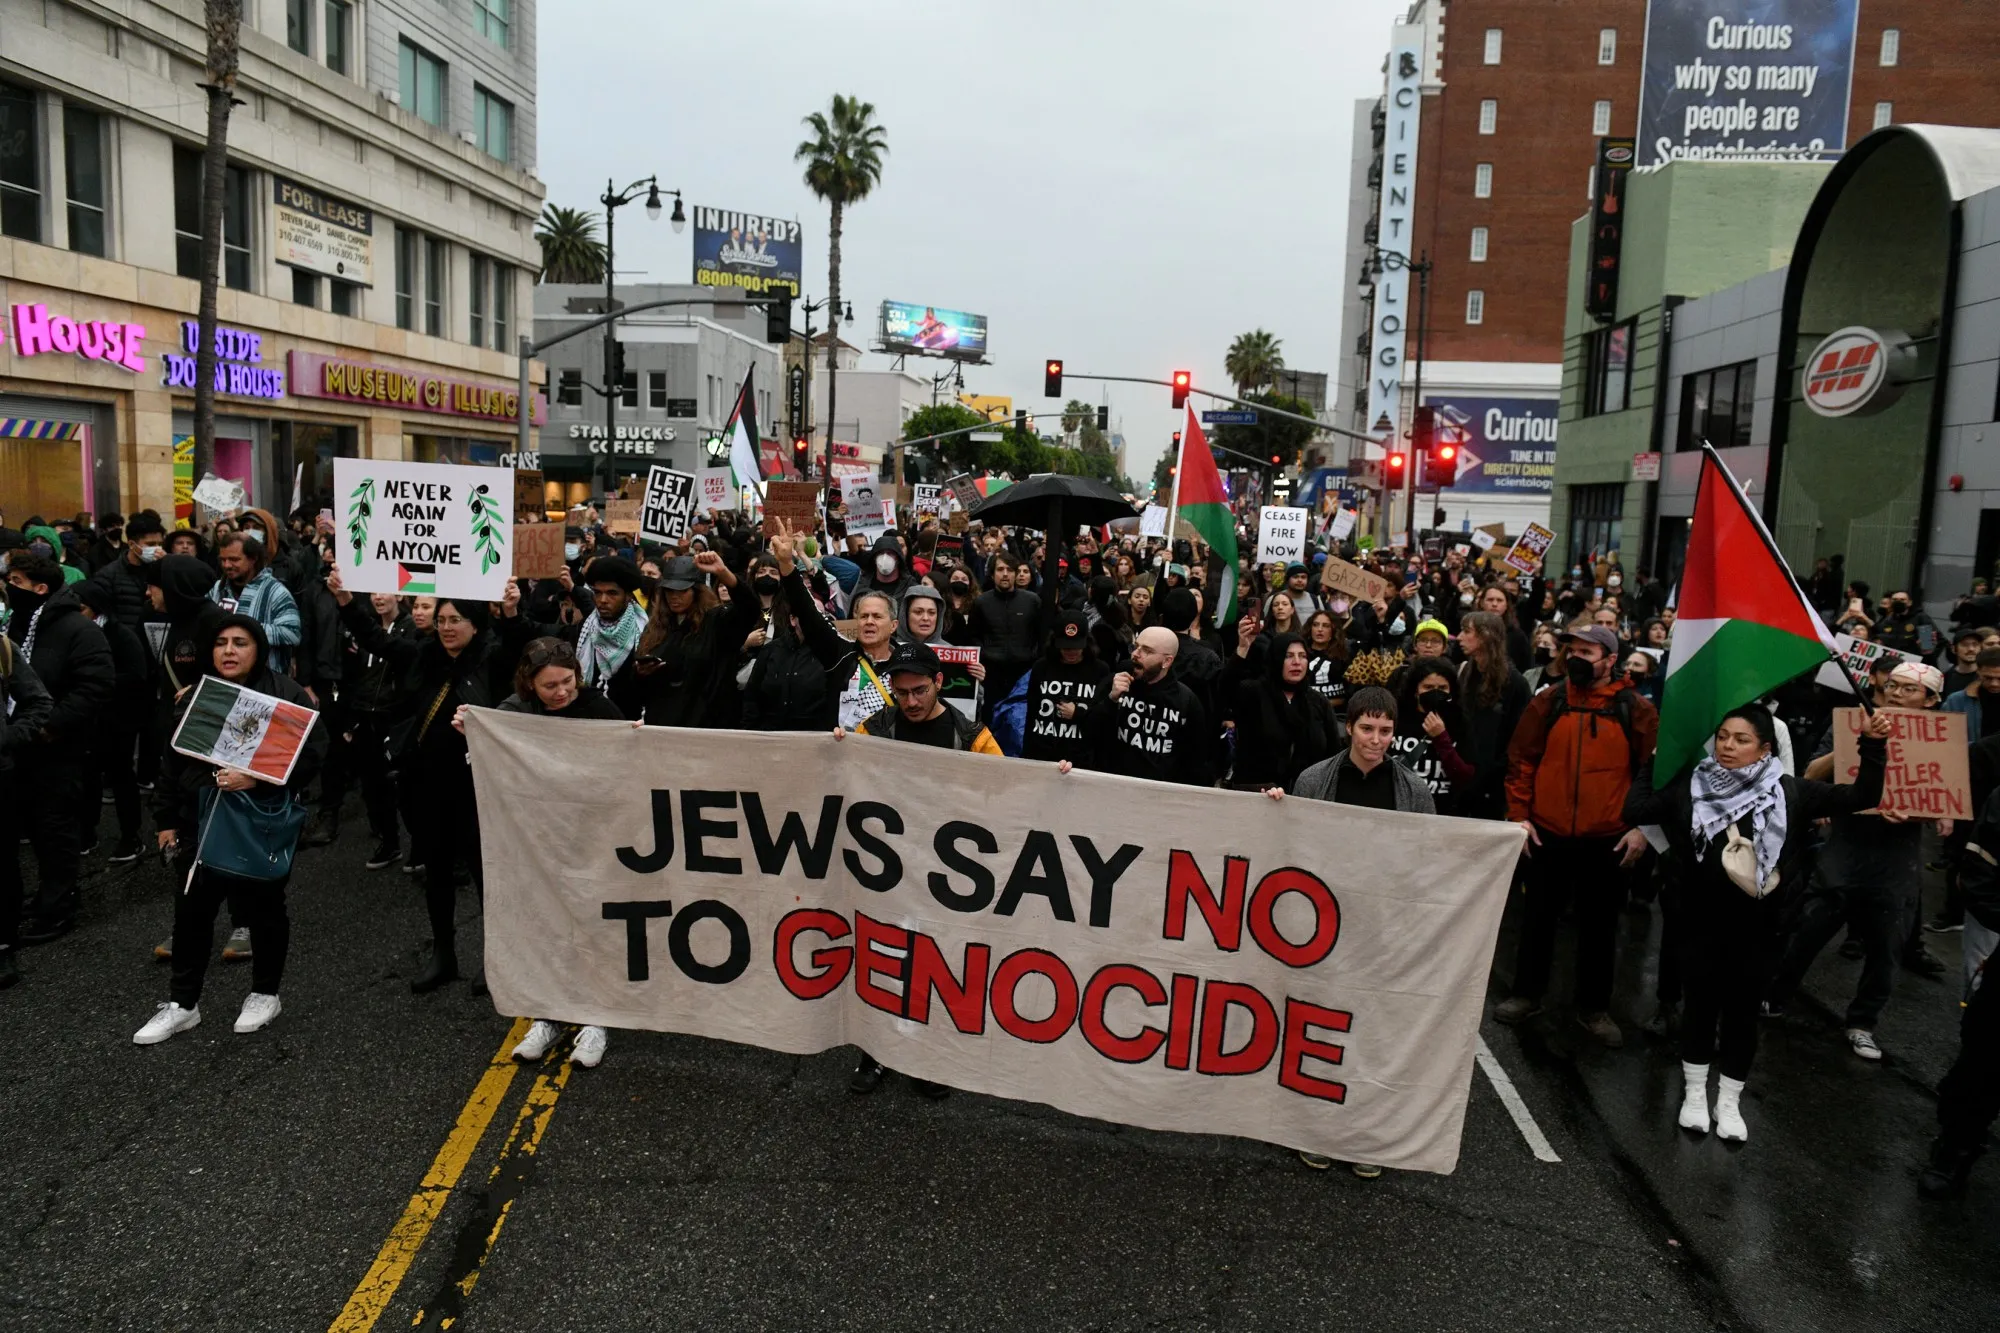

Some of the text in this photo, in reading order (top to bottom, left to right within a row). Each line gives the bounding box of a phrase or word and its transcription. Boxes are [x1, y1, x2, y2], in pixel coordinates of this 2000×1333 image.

[1706, 16, 1793, 50] Curious
[1675, 56, 1819, 97] why so many
[1684, 98, 1800, 137] people are
[281, 184, 366, 229] FOR LEASE
[697, 206, 799, 243] INJURED?
[12, 304, 145, 373] HOUSE
[182, 321, 262, 363] USIDE
[162, 354, 284, 398] DON HOUSE
[323, 360, 537, 420] MUSEUM OF ILLUSIOS
[1510, 450, 1533, 463] TUNE
[1533, 450, 1544, 463] IN
[704, 477, 724, 486] FREE
[1483, 463, 1520, 476] DIRECTV
[383, 480, 453, 501] NEVER
[653, 472, 687, 495] LET
[705, 486, 726, 495] GAZA
[919, 488, 938, 497] LET
[1325, 476, 1347, 490] GIFT
[392, 502, 446, 521] AGAIN
[647, 490, 687, 516] GAZA
[646, 509, 684, 538] LIVE
[1264, 511, 1301, 522] CEASE
[404, 523, 438, 538] FOR
[1271, 527, 1296, 539] FIRE
[376, 540, 461, 565] ANYONE
[1265, 546, 1298, 556] NOW
[1327, 563, 1367, 592] GAZA
[1850, 640, 1877, 658] END
[1039, 681, 1097, 698] NOT IN
[1119, 695, 1181, 723] NOT IN
[1032, 719, 1083, 739] NAM
[1127, 712, 1170, 737] OUR
[1117, 726, 1173, 754] NAME
[615, 789, 1341, 968] JEWS SAY NO
[602, 899, 1352, 1104] TO GENOCIDE
